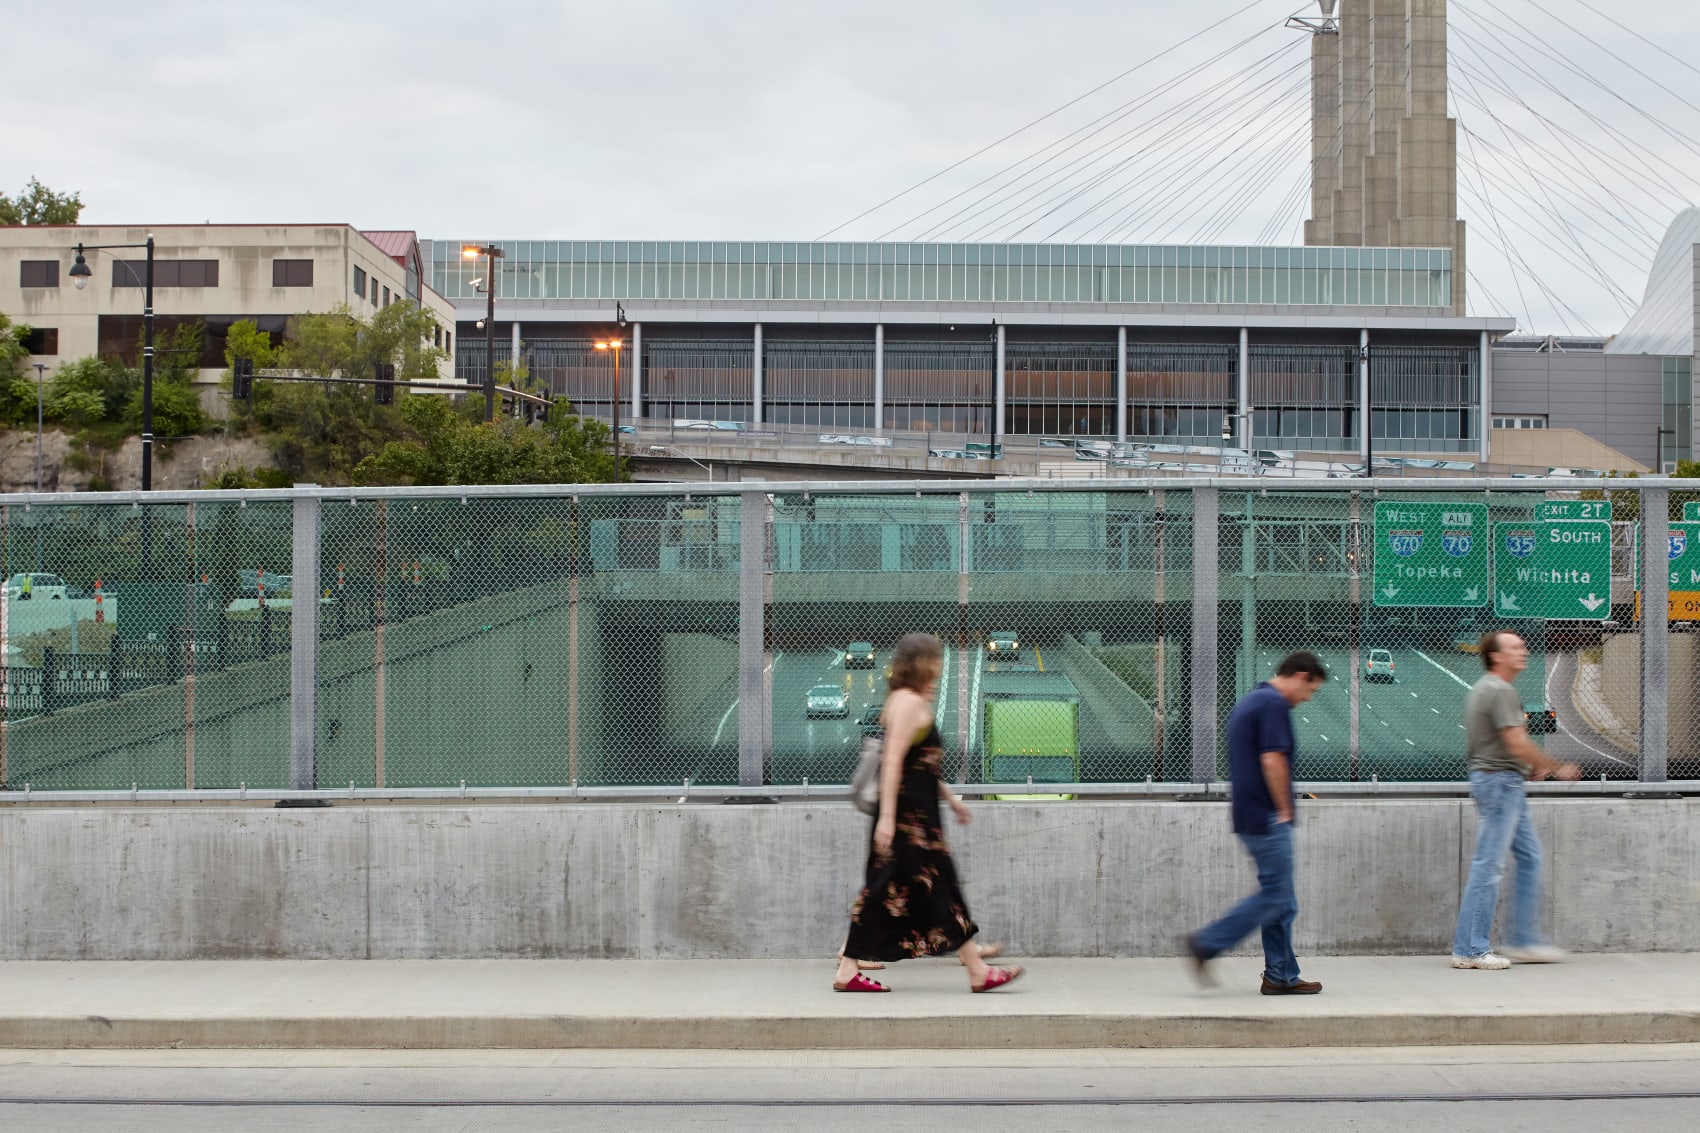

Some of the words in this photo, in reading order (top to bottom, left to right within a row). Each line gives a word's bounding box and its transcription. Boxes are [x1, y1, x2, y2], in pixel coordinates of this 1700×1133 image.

[1386, 510, 1426, 523] WEST
[1543, 505, 1569, 515] EXIT
[1581, 503, 1603, 517] 2T
[1448, 514, 1468, 523] ALT
[1550, 528, 1601, 543] SOUTH
[1393, 537, 1419, 552] 670
[1444, 537, 1470, 552] 70
[1509, 537, 1533, 552] 35
[1395, 564, 1462, 581] Topeka
[1517, 567, 1592, 584] Wichita
